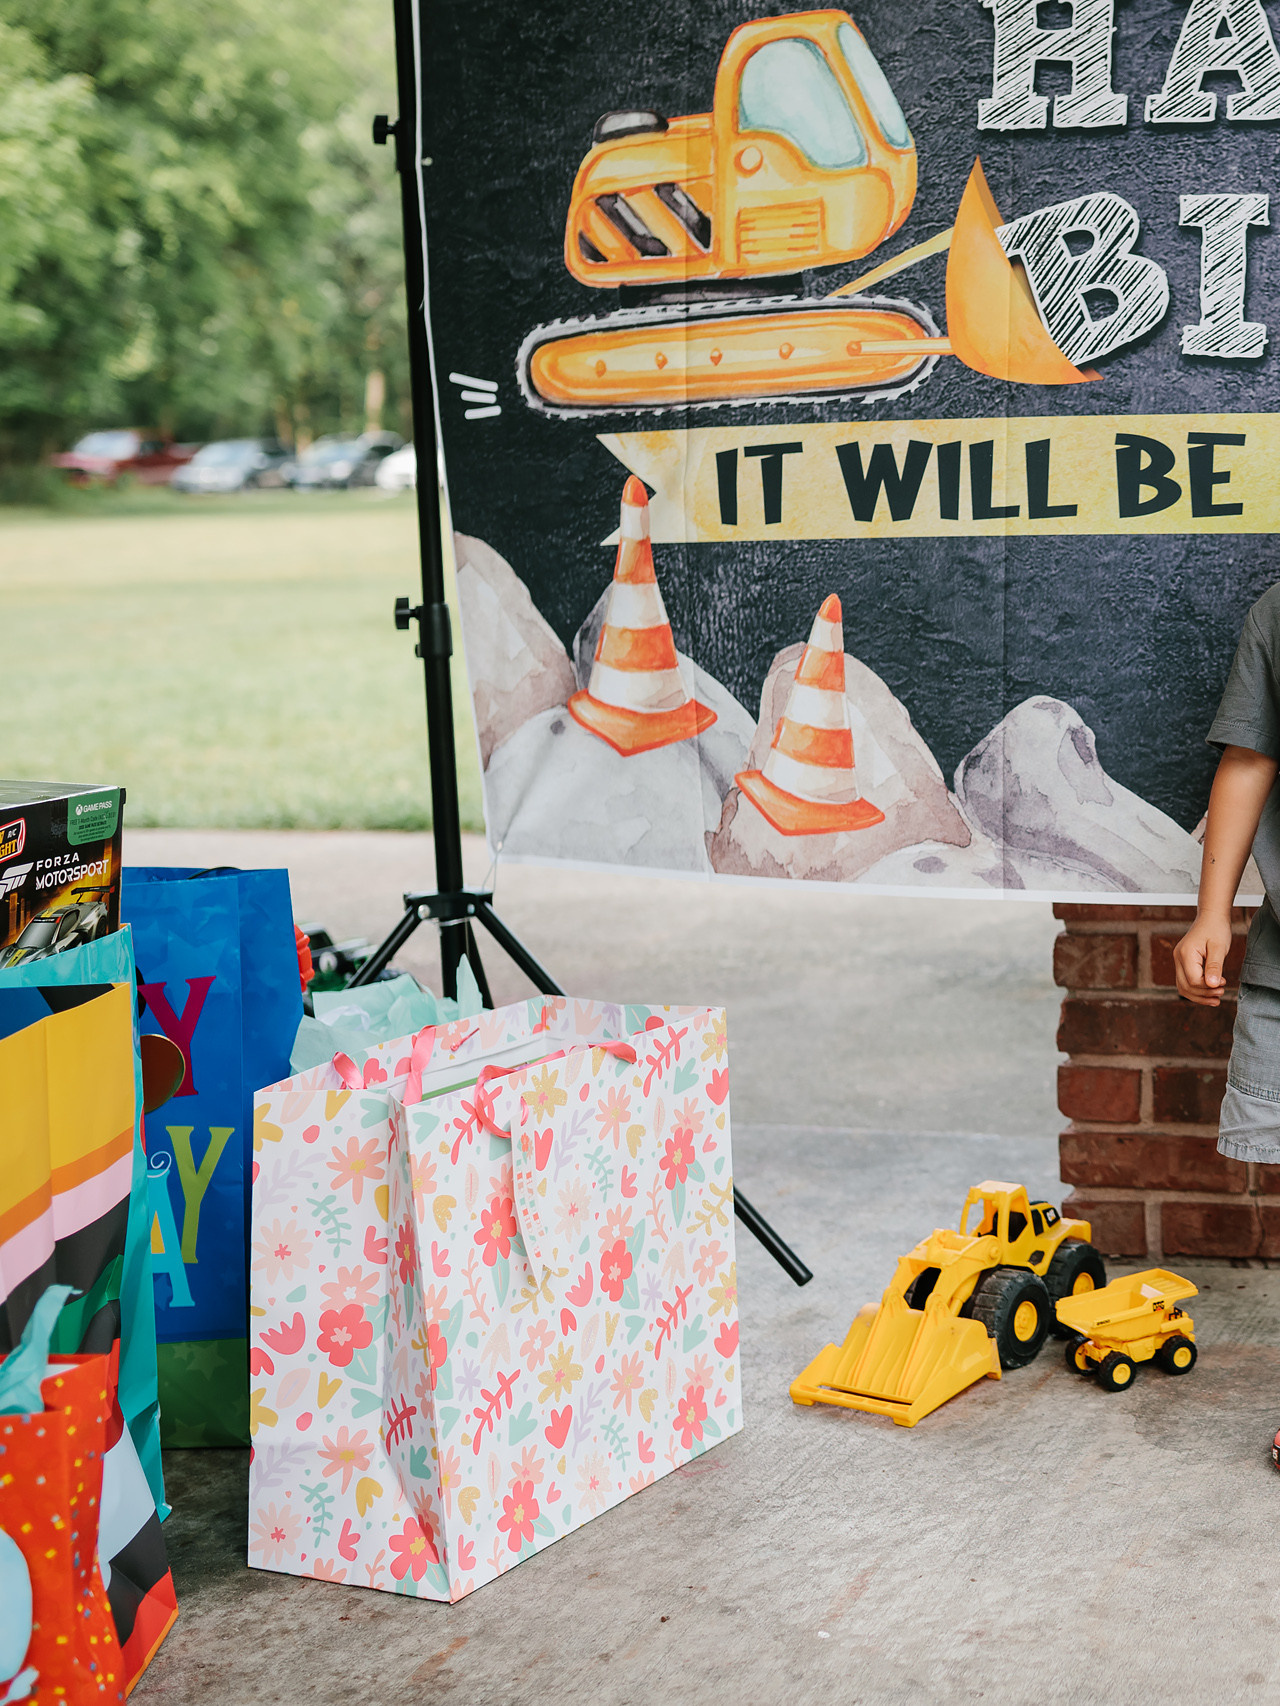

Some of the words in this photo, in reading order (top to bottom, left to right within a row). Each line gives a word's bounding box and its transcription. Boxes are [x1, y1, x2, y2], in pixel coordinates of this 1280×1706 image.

[715, 441, 803, 525] IT
[836, 438, 1078, 523] WILL
[1115, 432, 1246, 519] BE
[84, 803, 98, 812] GAME
[99, 800, 112, 810] PASS
[35, 858, 110, 891] MOTORSPORT
[36, 852, 80, 871] FORZA
